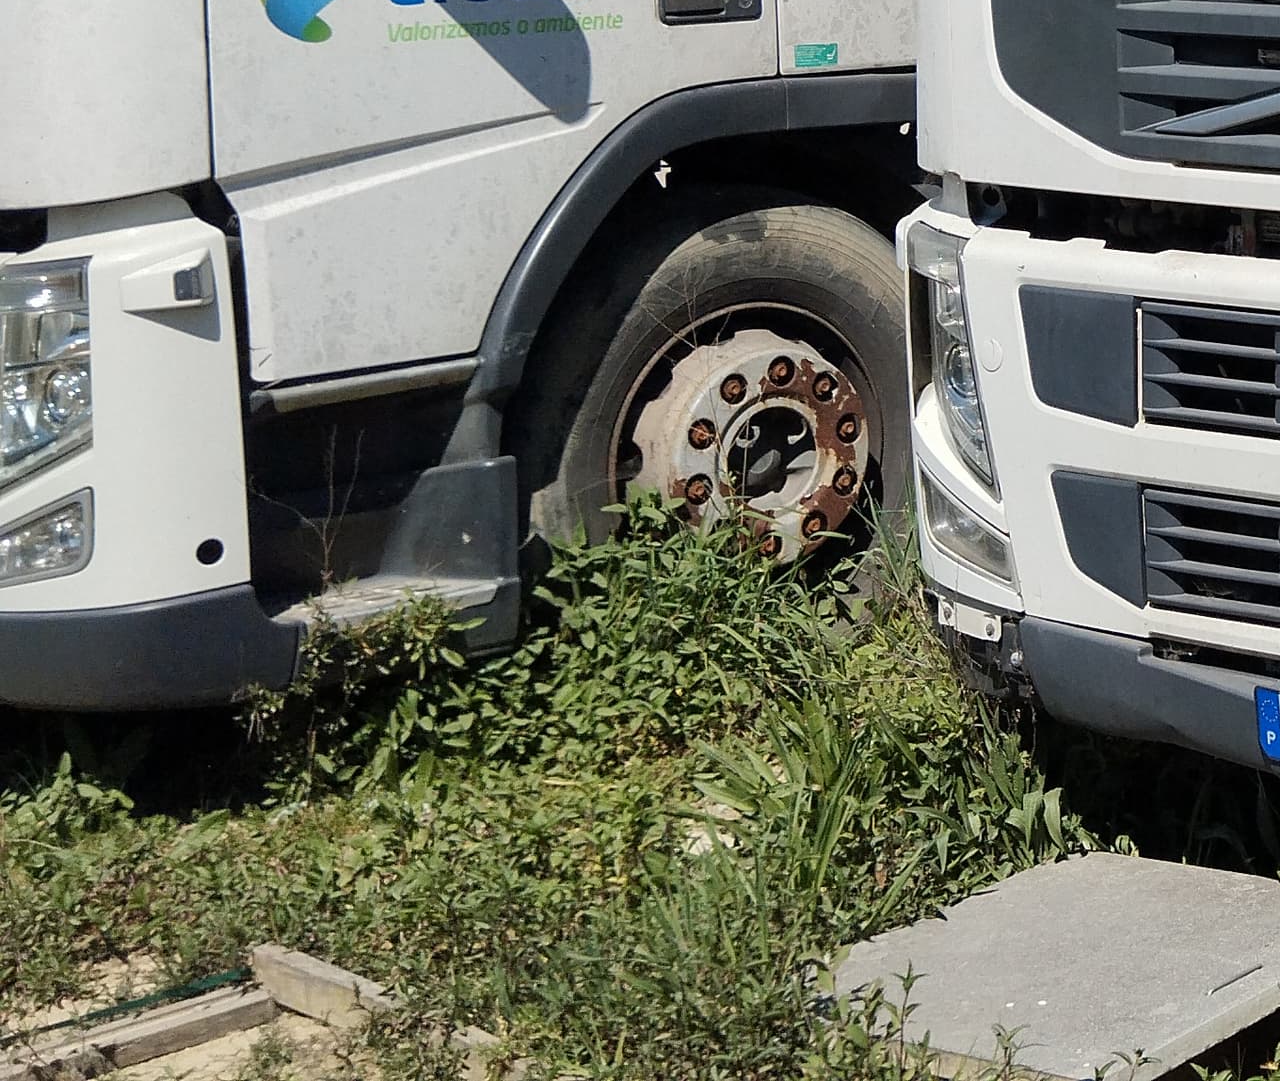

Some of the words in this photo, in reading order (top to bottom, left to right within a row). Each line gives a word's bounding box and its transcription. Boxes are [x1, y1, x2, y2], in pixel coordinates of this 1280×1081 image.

[387, 21, 511, 43] Valorizamos
[517, 20, 529, 33] o
[534, 12, 624, 33] ambiente
[1266, 730, 1276, 745] P
